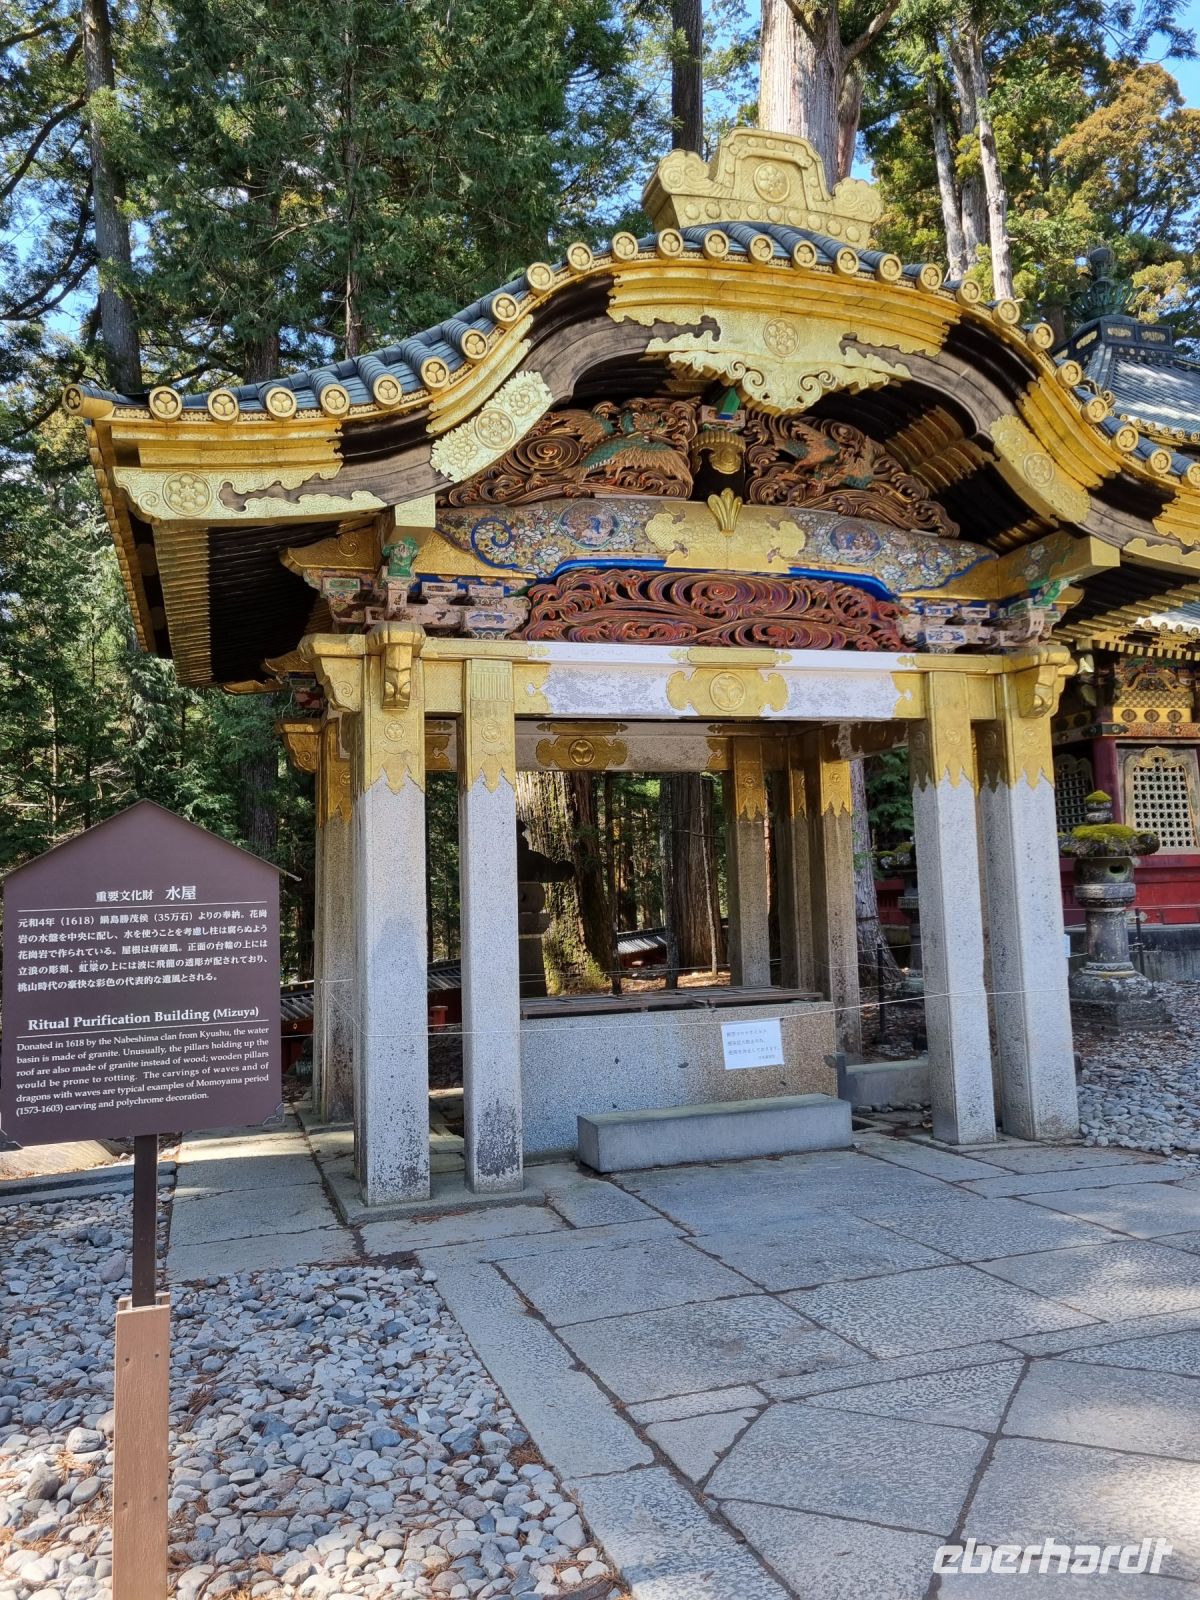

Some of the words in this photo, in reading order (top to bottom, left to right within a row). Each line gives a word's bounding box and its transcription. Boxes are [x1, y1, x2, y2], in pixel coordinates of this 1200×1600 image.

[96, 890, 153, 902] 重要文化財
[165, 886, 196, 900] 水屋
[28, 1017, 69, 1030] Ritual
[73, 1013, 151, 1027] Purification
[155, 1009, 210, 1022] Building
[213, 1007, 259, 1020] (Mizuya)
[17, 1040, 53, 1051] Donated
[66, 1039, 84, 1047] 1618
[86, 1038, 96, 1047] by
[98, 1037, 111, 1045] the
[113, 1033, 159, 1044] Nabeshima
[178, 1031, 198, 1039] from
[199, 1030, 232, 1039] Kyushu,
[234, 1028, 246, 1036] the
[17, 1055, 40, 1064] basin
[52, 1052, 76, 1061] made
[78, 1051, 87, 1059] of
[88, 1050, 120, 1060] granite.
[123, 1045, 167, 1056] Unusually,
[169, 1044, 182, 1052] the
[184, 1041, 210, 1053] pillars
[211, 1039, 242, 1049] holding
[244, 1039, 255, 1047] up
[257, 1038, 269, 1046] the
[16, 1067, 35, 1076] roof
[52, 1065, 70, 1073] also
[72, 1063, 96, 1072] made
[98, 1062, 107, 1070] of
[109, 1059, 139, 1069] granite
[140, 1057, 170, 1066] instead
[183, 1054, 208, 1063] wood;
[210, 1052, 242, 1061] wooden
[244, 1051, 269, 1060] pillars
[16, 1079, 46, 1089] would
[49, 1079, 61, 1087] be
[63, 1077, 90, 1088] prone
[104, 1073, 138, 1083] rotting.
[143, 1070, 159, 1079] The
[162, 1068, 199, 1077] carvings
[202, 1066, 211, 1074] of
[213, 1065, 240, 1073] waves
[242, 1063, 258, 1071] and
[16, 1092, 51, 1103] dragons
[53, 1090, 73, 1099] with
[74, 1088, 101, 1097] waves
[102, 1087, 116, 1095] are
[117, 1084, 145, 1095] typical
[146, 1081, 185, 1092] examples
[186, 1080, 195, 1088] of
[196, 1076, 243, 1087] Momoyama
[244, 1074, 269, 1084] period
[16, 1103, 64, 1117] (1573-1603)
[65, 1100, 97, 1111] carving
[98, 1099, 114, 1108] and
[116, 1096, 164, 1108] polychrome
[165, 1091, 209, 1102] decoration.
